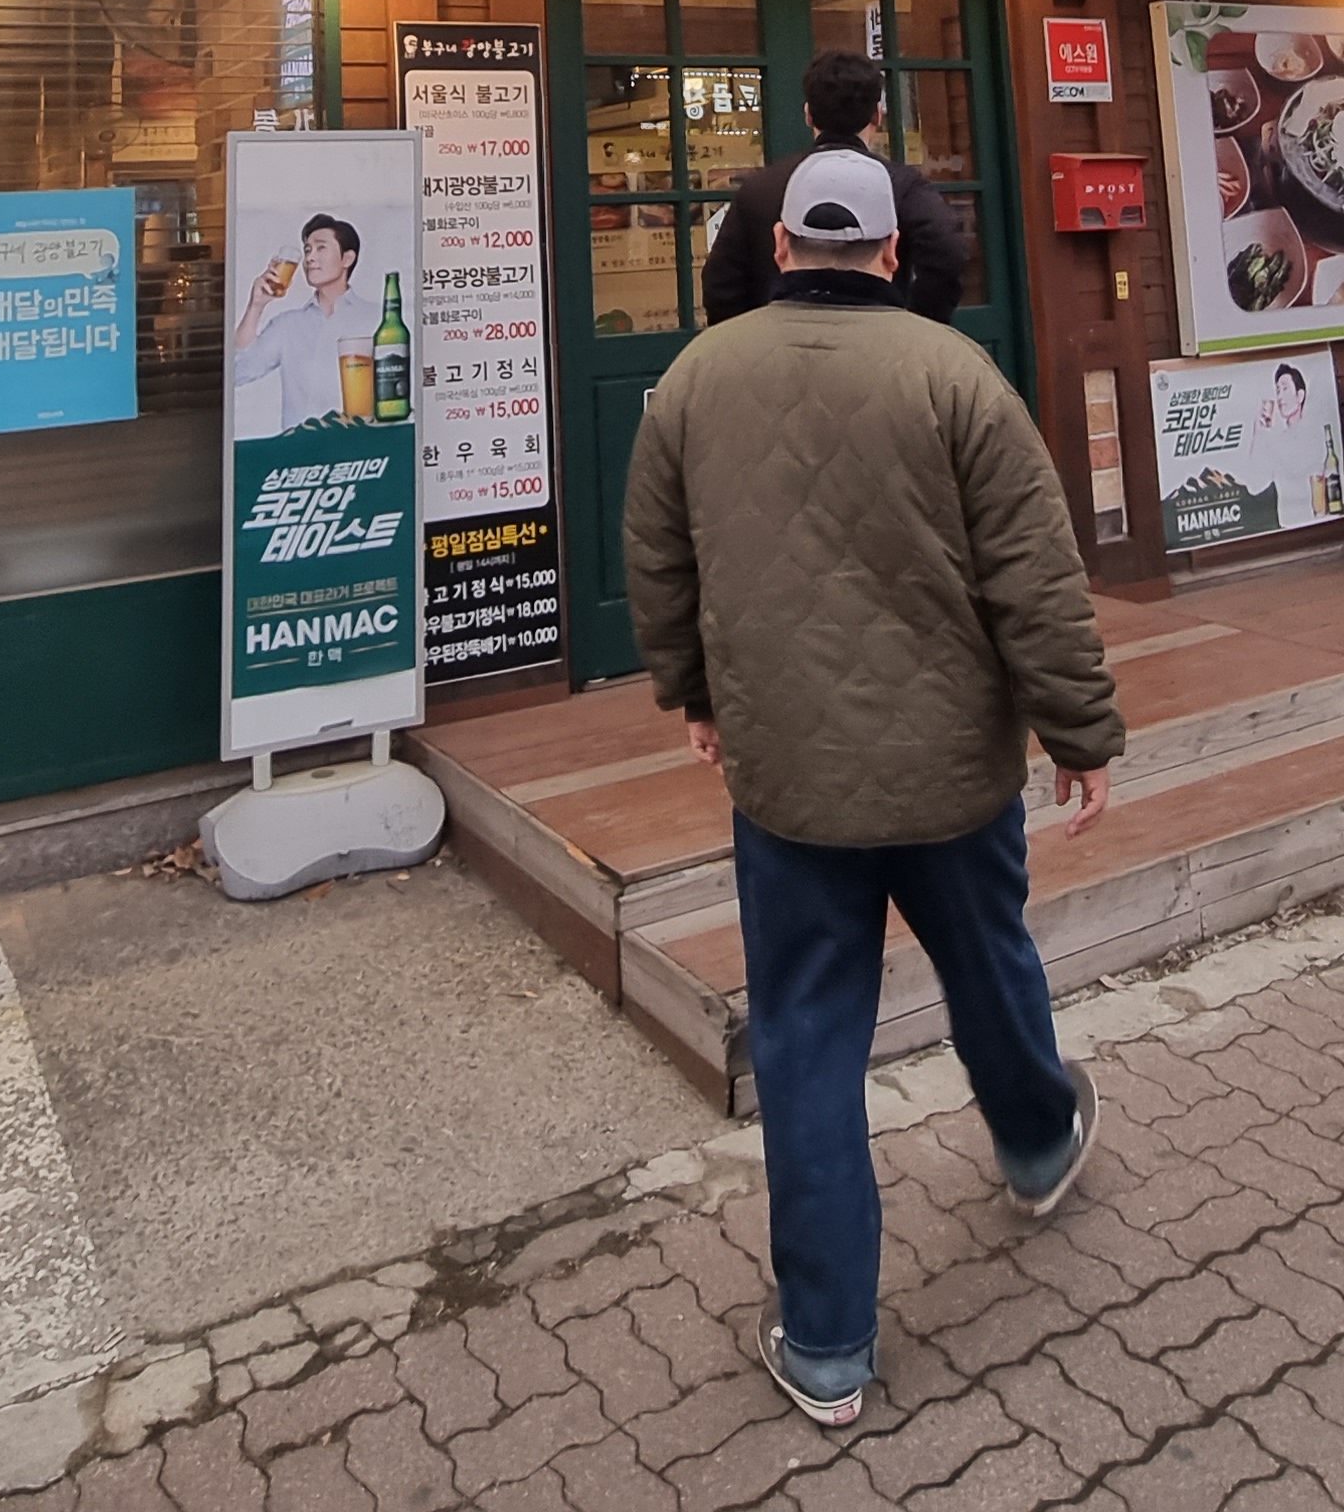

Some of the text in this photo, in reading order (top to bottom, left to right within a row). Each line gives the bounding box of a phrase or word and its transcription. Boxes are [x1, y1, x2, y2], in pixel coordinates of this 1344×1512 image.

[421, 37, 533, 60] 봉구네 광양불고기
[1058, 42, 1098, 64] 에스원
[412, 84, 528, 104] 서울식 불고기
[438, 143, 462, 155] 250g
[1098, 183, 1136, 195] POST
[441, 236, 465, 248] 200g
[443, 328, 468, 341] 200g
[1161, 404, 1217, 434] 코리안
[1173, 424, 1244, 458] 테이스트
[261, 456, 389, 492] 상쾌한 풍미의
[241, 484, 356, 530] 코리안
[1176, 504, 1242, 533] HANMAC
[259, 511, 404, 563] 테이스트
[246, 604, 399, 655] HANMAC
